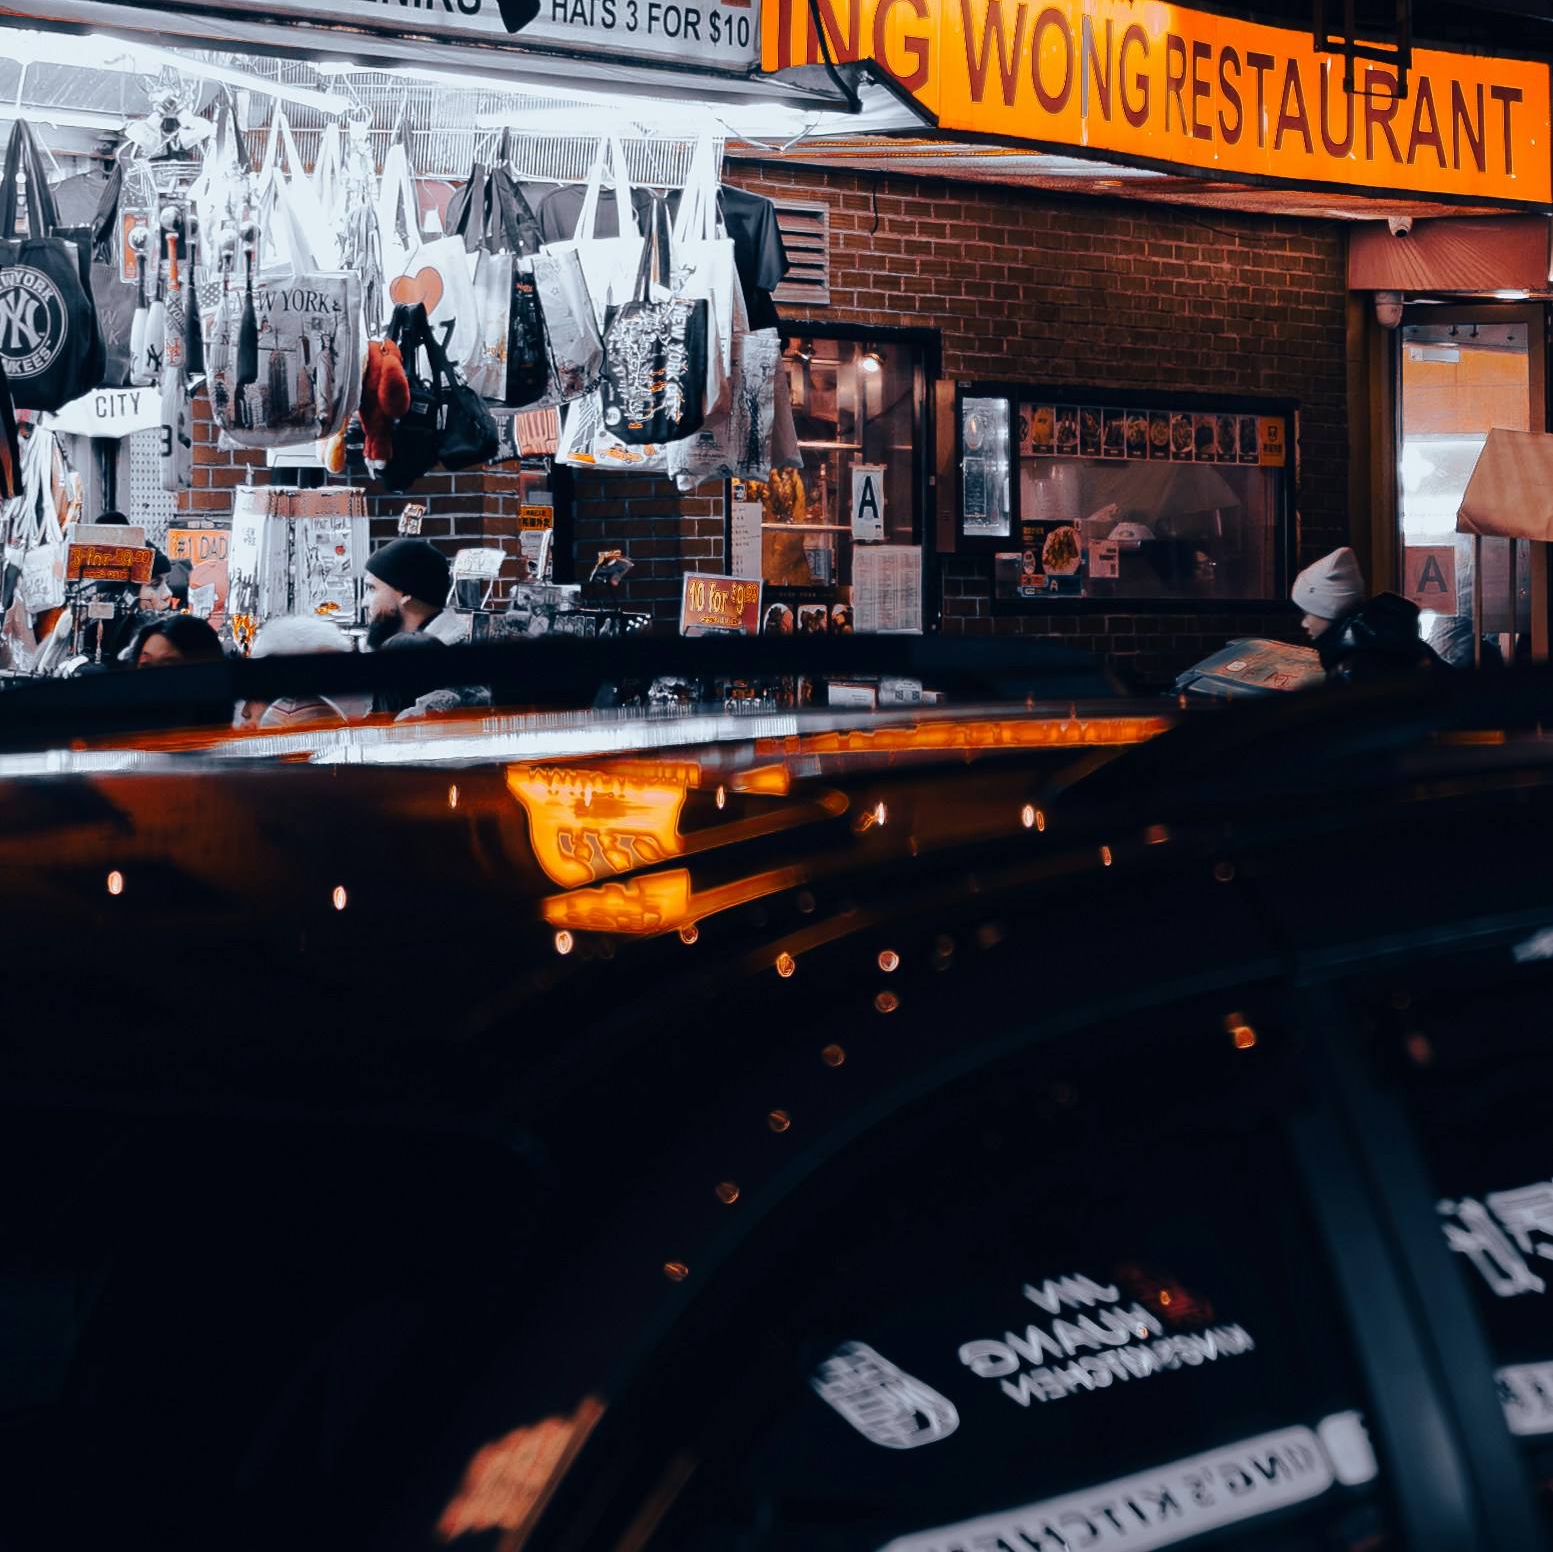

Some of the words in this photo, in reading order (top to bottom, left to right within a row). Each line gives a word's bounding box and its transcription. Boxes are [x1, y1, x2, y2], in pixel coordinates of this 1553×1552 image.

[626, 0, 639, 32] 3
[648, 2, 702, 41] FOR
[709, 9, 750, 48] $10
[1165, 32, 1524, 176] RESTAURANT
[281, 289, 330, 313] YORK
[671, 305, 688, 341] NEW
[95, 392, 141, 419] CITY
[856, 475, 880, 520] A
[71, 548, 82, 570] 3
[177, 537, 193, 560] #1
[200, 536, 229, 560] DAD
[1416, 553, 1448, 594] A
[689, 580, 705, 613] 10
